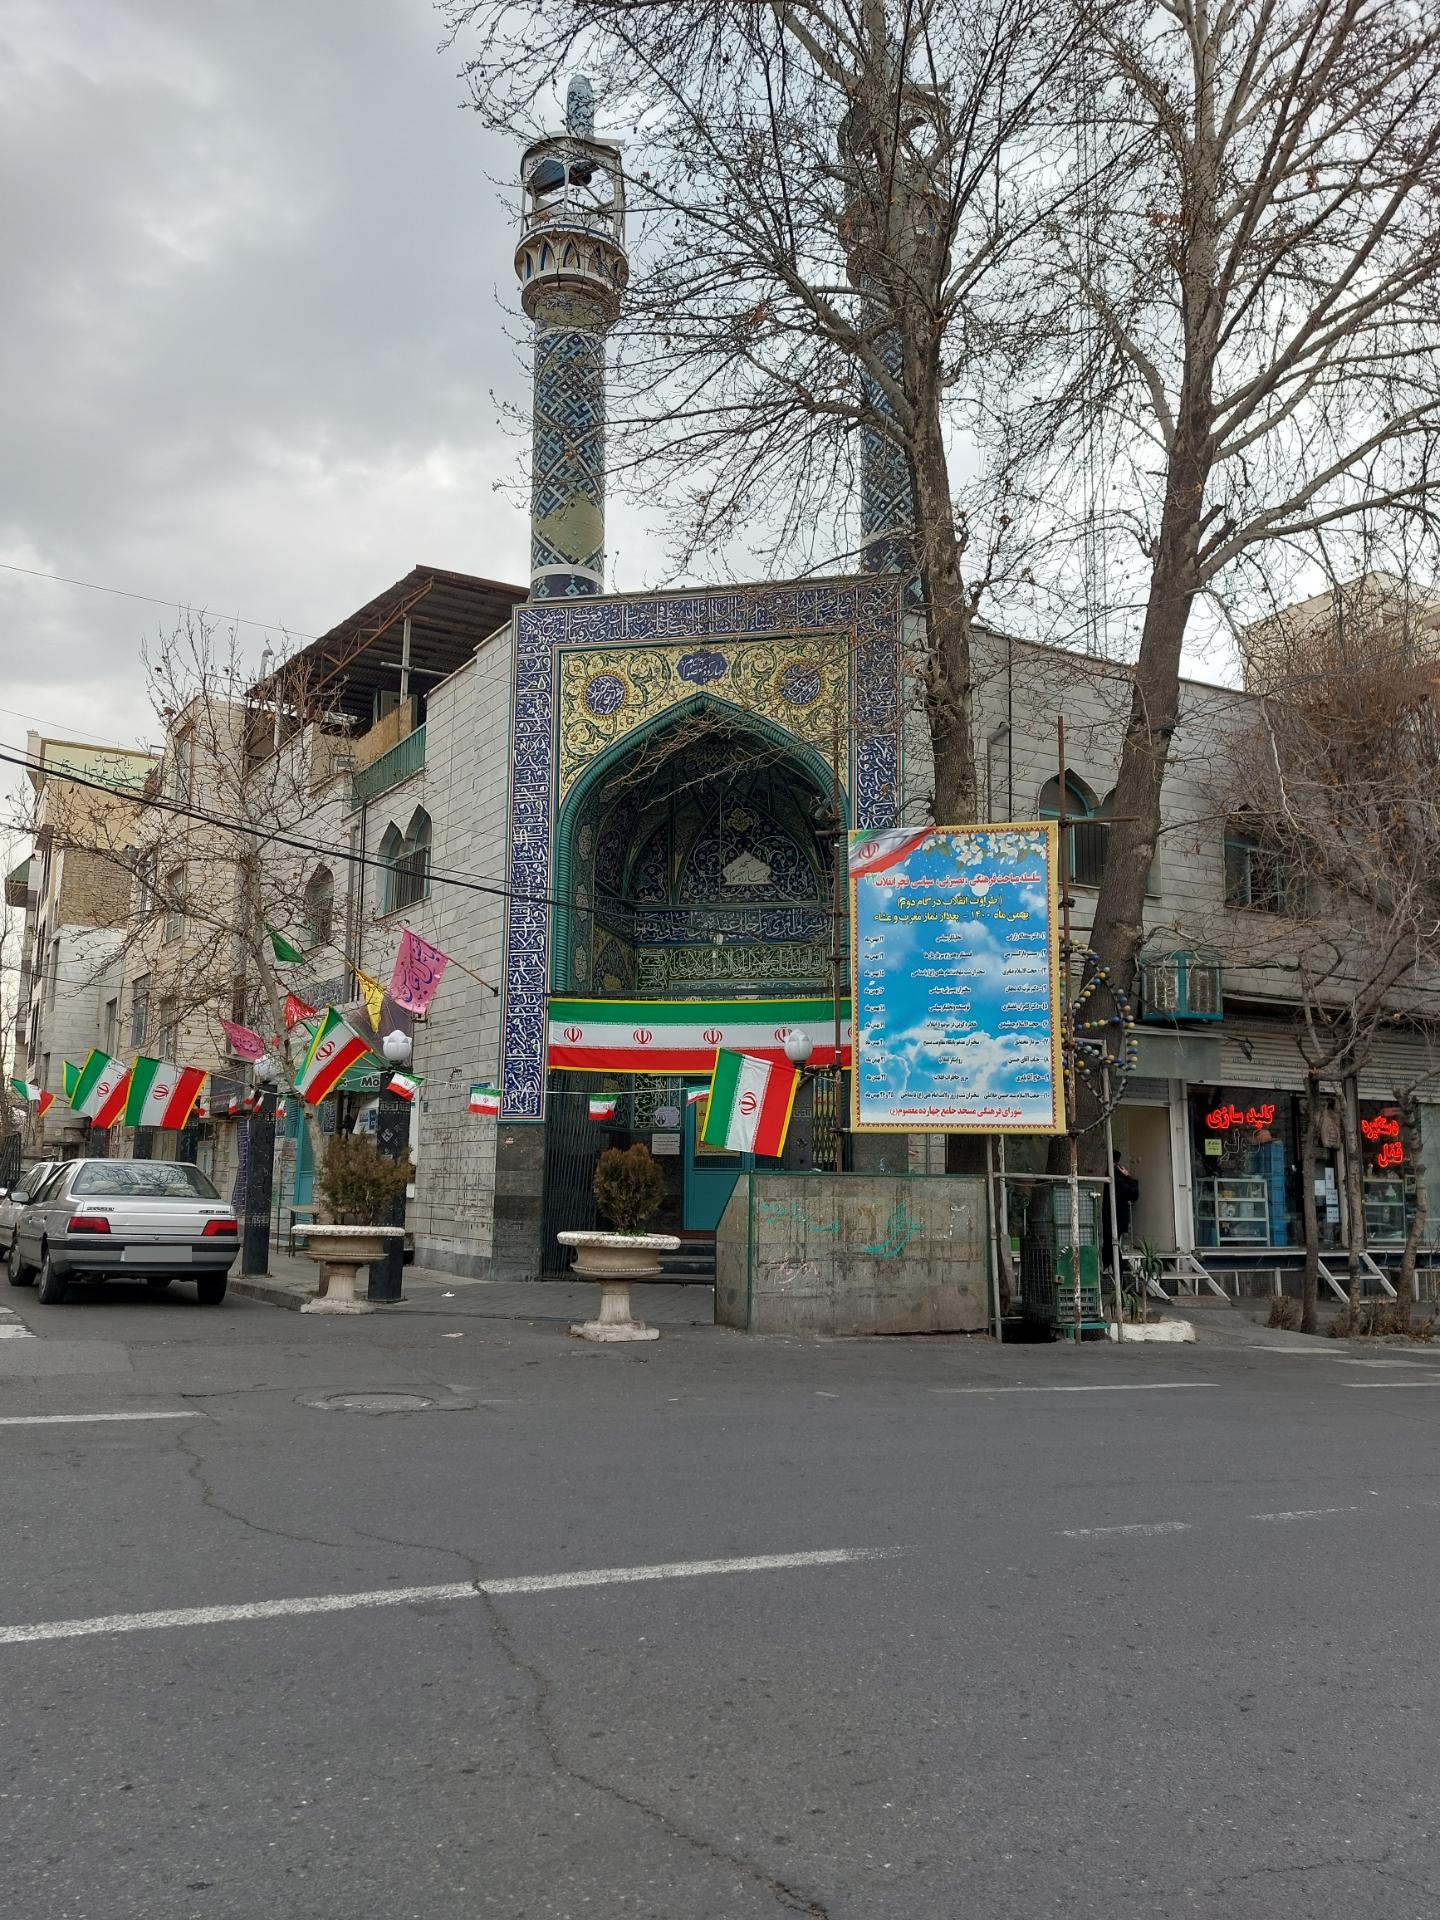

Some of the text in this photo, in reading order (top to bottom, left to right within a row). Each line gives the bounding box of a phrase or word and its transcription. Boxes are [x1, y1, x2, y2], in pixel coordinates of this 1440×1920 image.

[875, 876, 895, 888] انقلاب
[911, 875, 934, 888] سیاسی
[917, 896, 931, 908] گام
[932, 898, 941, 908] در
[943, 896, 968, 909] انقلاب
[874, 912, 892, 922] عشاء
[900, 912, 922, 924] مغرب
[922, 911, 938, 923] نماز
[971, 911, 990, 920] ۱۴۰۰
[993, 909, 1006, 920] ماه
[1007, 911, 1029, 922] بهمن
[941, 1105, 956, 1117] جامع
[957, 1108, 976, 1117] مسجد
[977, 1106, 1001, 1117] فرهنگی
[1001, 1105, 1022, 1117] شورای
[1207, 1104, 1275, 1128] کلید سازی
[1361, 1116, 1399, 1139] دستگیره
[1378, 1142, 1403, 1168] قفل
